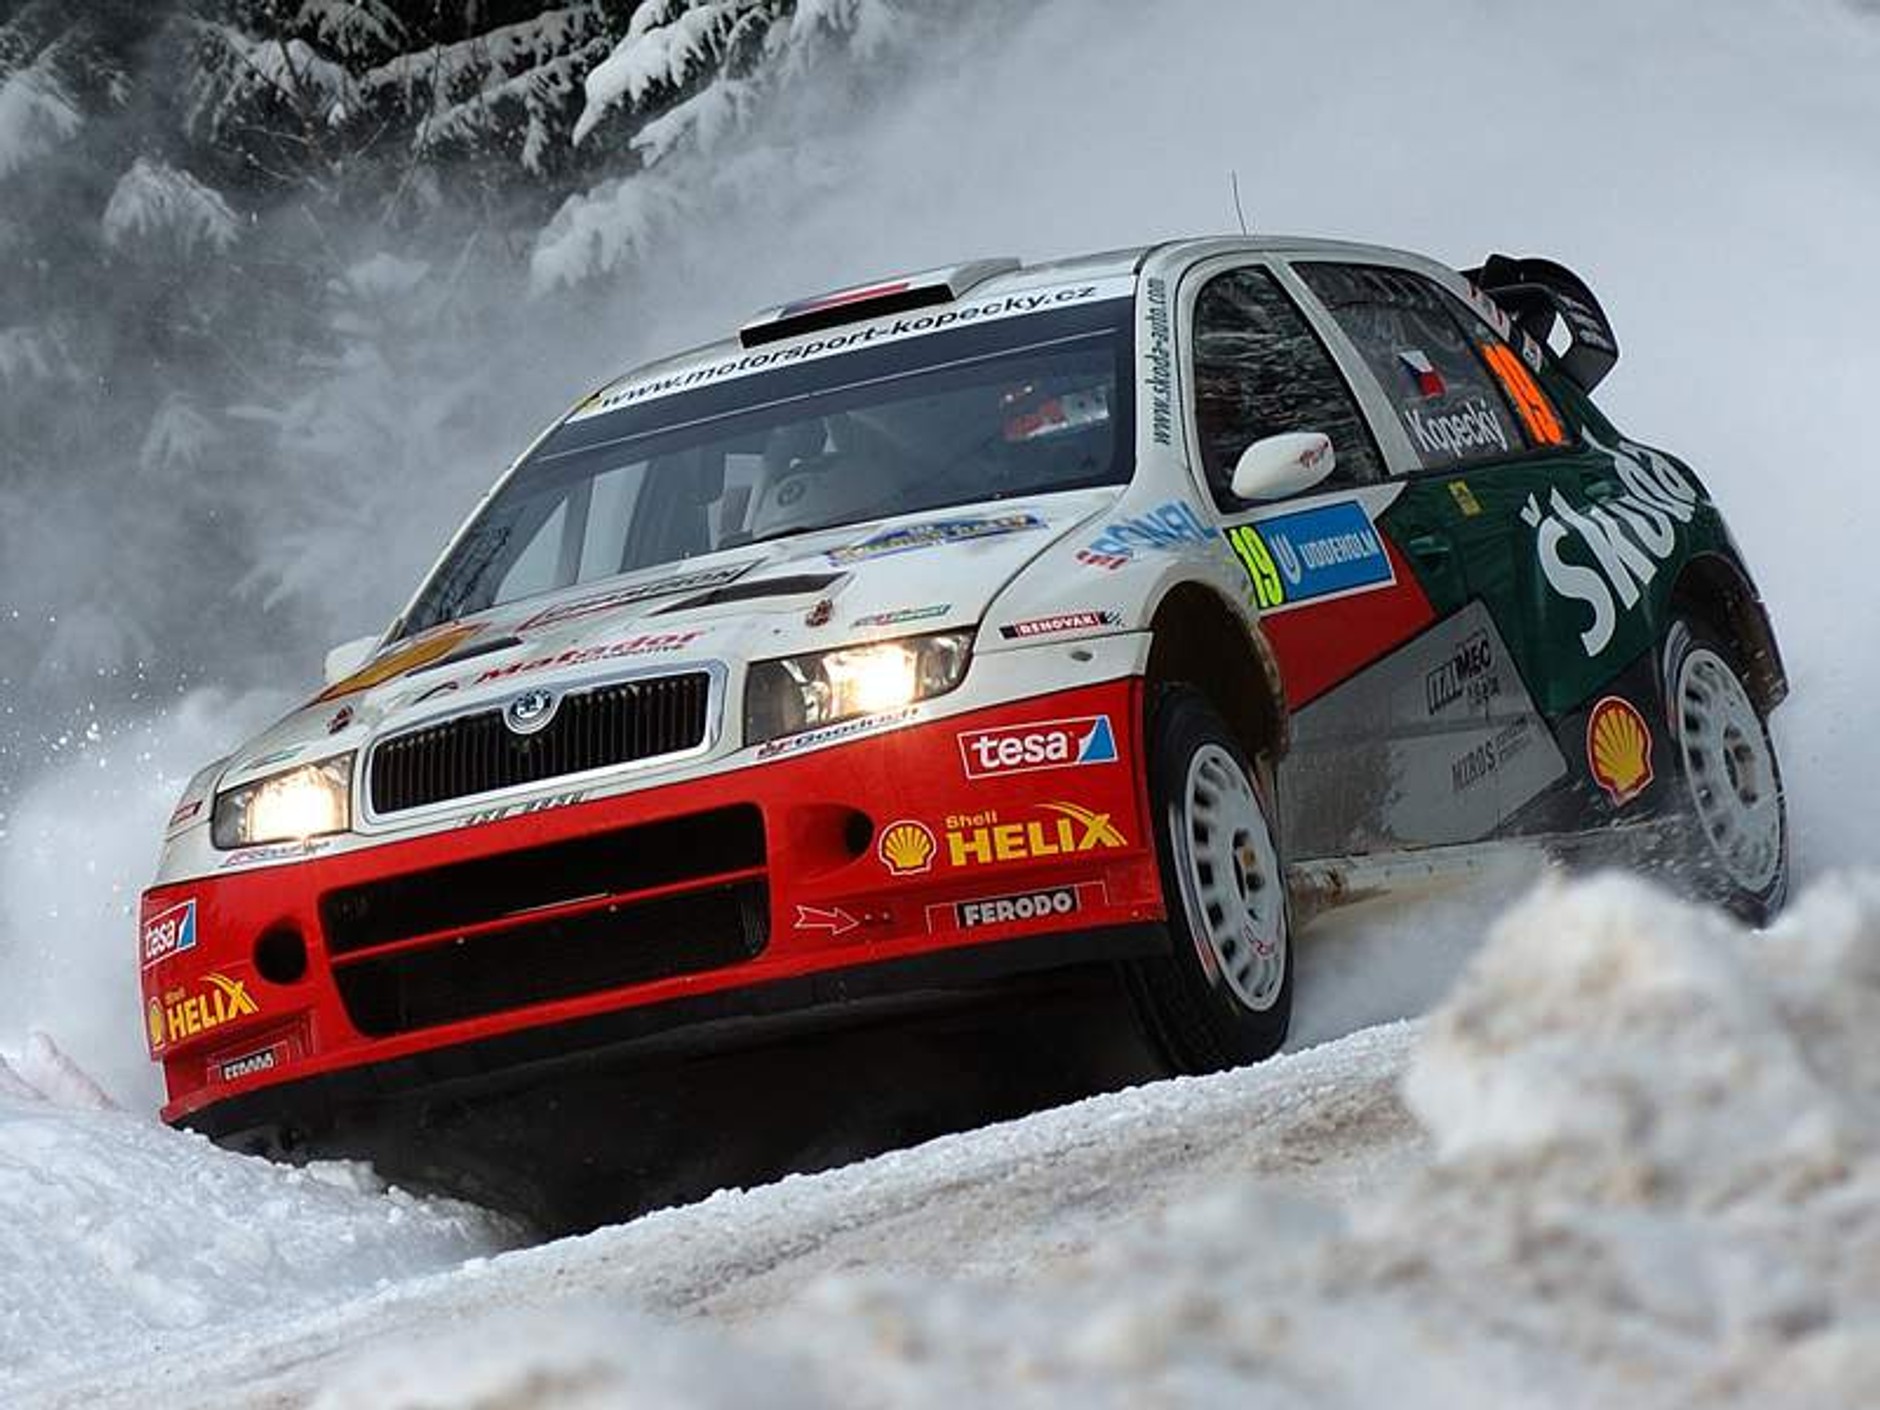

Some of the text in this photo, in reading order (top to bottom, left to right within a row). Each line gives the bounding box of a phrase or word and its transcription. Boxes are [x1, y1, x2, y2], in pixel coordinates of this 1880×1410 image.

[600, 285, 1097, 408] www.motorsport-kopecky.cz
[1404, 398, 1508, 458] Kopecký
[1228, 526, 1284, 608] 19
[971, 730, 1068, 769] tesa
[945, 801, 1127, 866] HELIX
[946, 811, 997, 829] Shell
[963, 889, 1073, 926] FERODO
[145, 919, 175, 959] tesa
[166, 972, 259, 1042] HELIX
